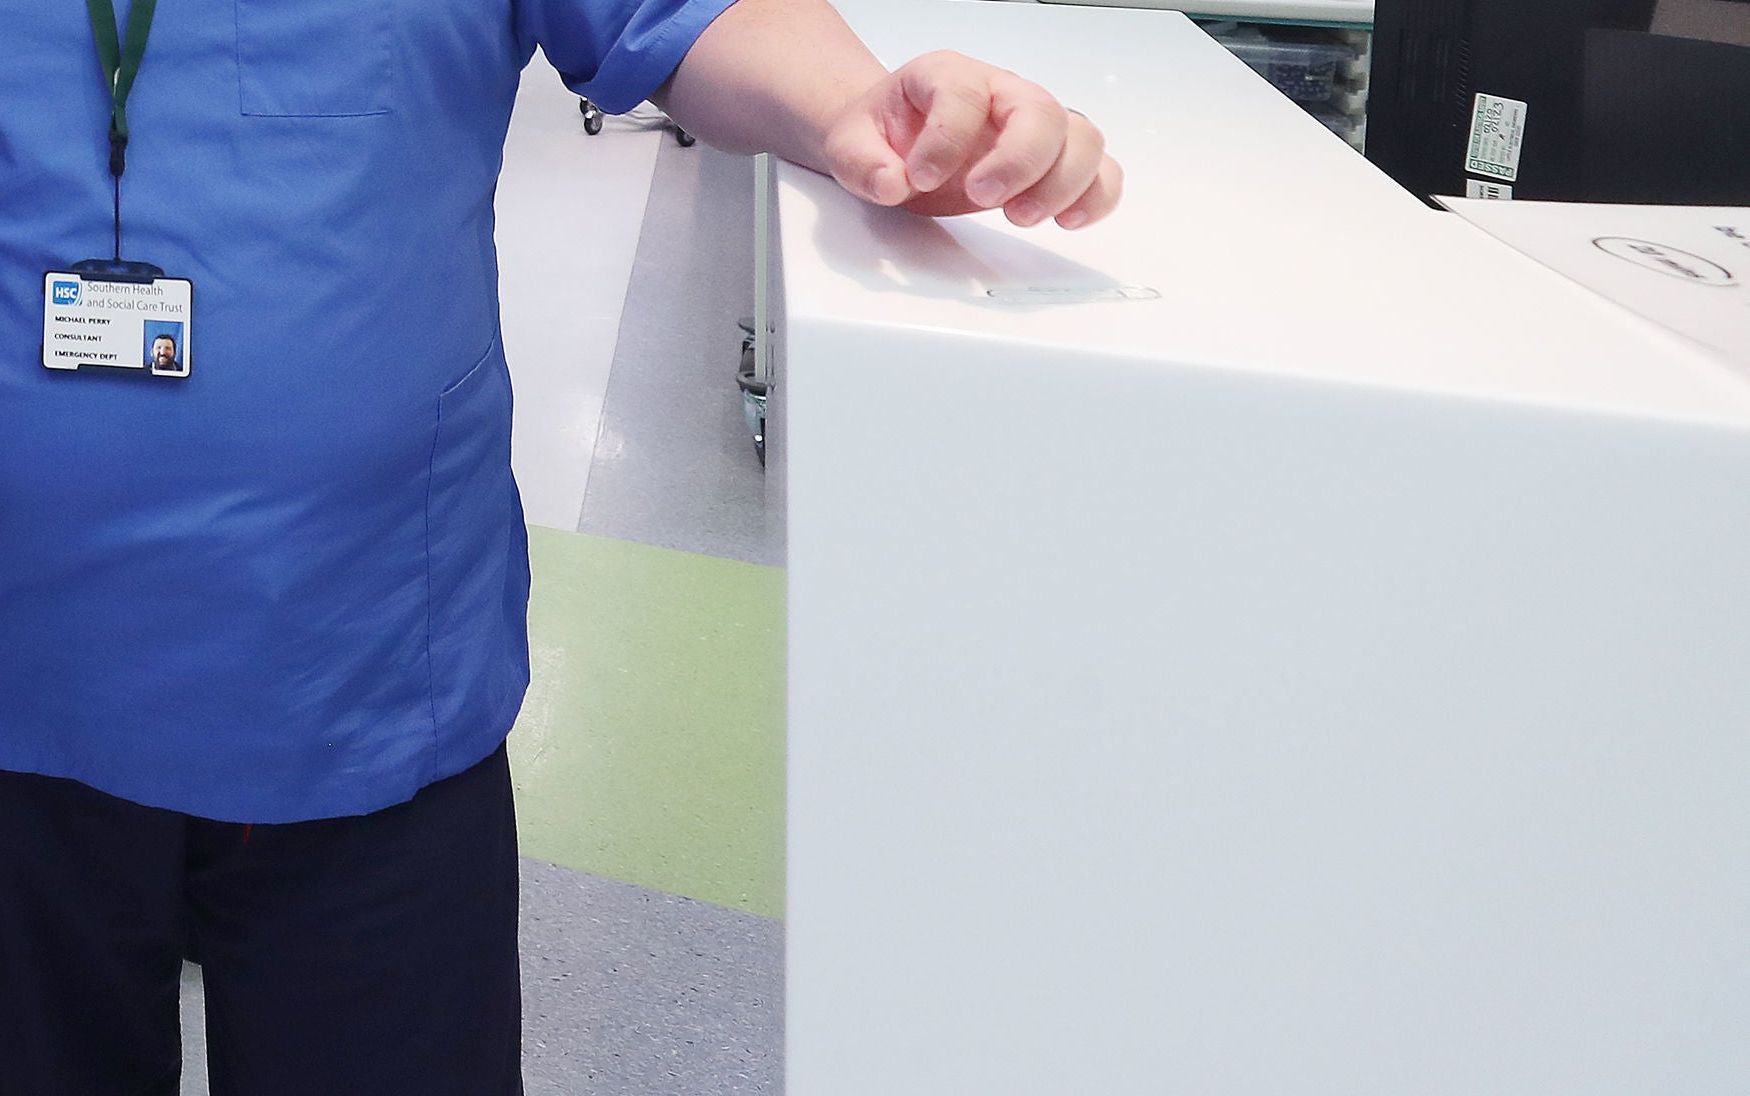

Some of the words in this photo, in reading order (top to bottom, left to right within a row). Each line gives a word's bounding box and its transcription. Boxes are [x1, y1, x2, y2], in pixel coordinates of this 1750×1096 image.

[1470, 159, 1514, 178] PASSED
[55, 288, 77, 298] HSC
[88, 282, 130, 294] Southern
[133, 285, 163, 296] Health
[87, 300, 104, 309] and
[108, 300, 135, 310] Social
[137, 302, 158, 311] Care
[161, 303, 182, 313] Trust
[55, 316, 86, 324] MICHAEL
[55, 333, 102, 342] CONSULTANT
[55, 351, 98, 359] EMERGENCY
